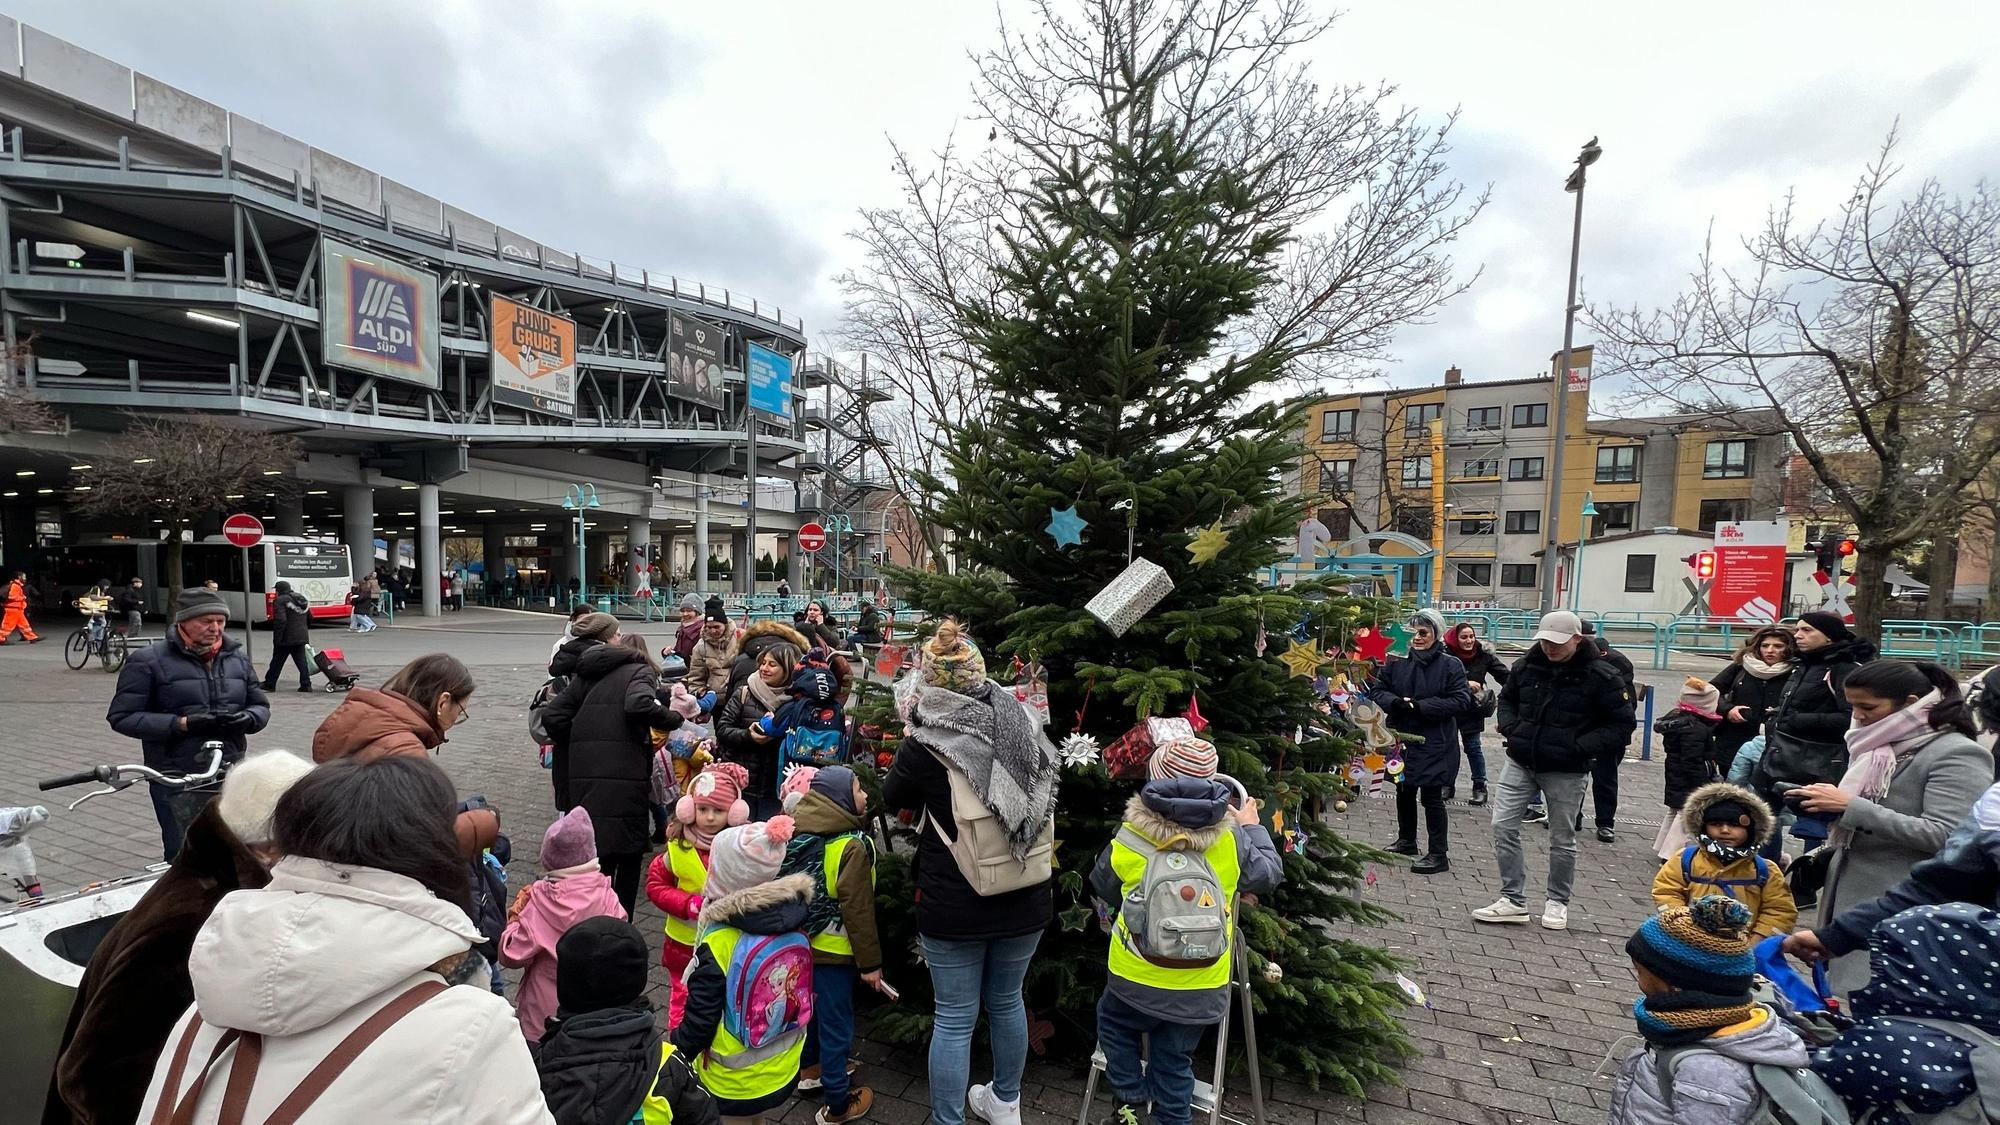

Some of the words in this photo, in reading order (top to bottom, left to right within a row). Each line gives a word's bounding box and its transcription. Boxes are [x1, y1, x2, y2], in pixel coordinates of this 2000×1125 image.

[358, 318, 412, 348] ALDI
[516, 307, 557, 333] FUND-
[376, 340, 397, 354] SÜD
[515, 326, 558, 355] GRUBE
[546, 400, 573, 416] SATURN
